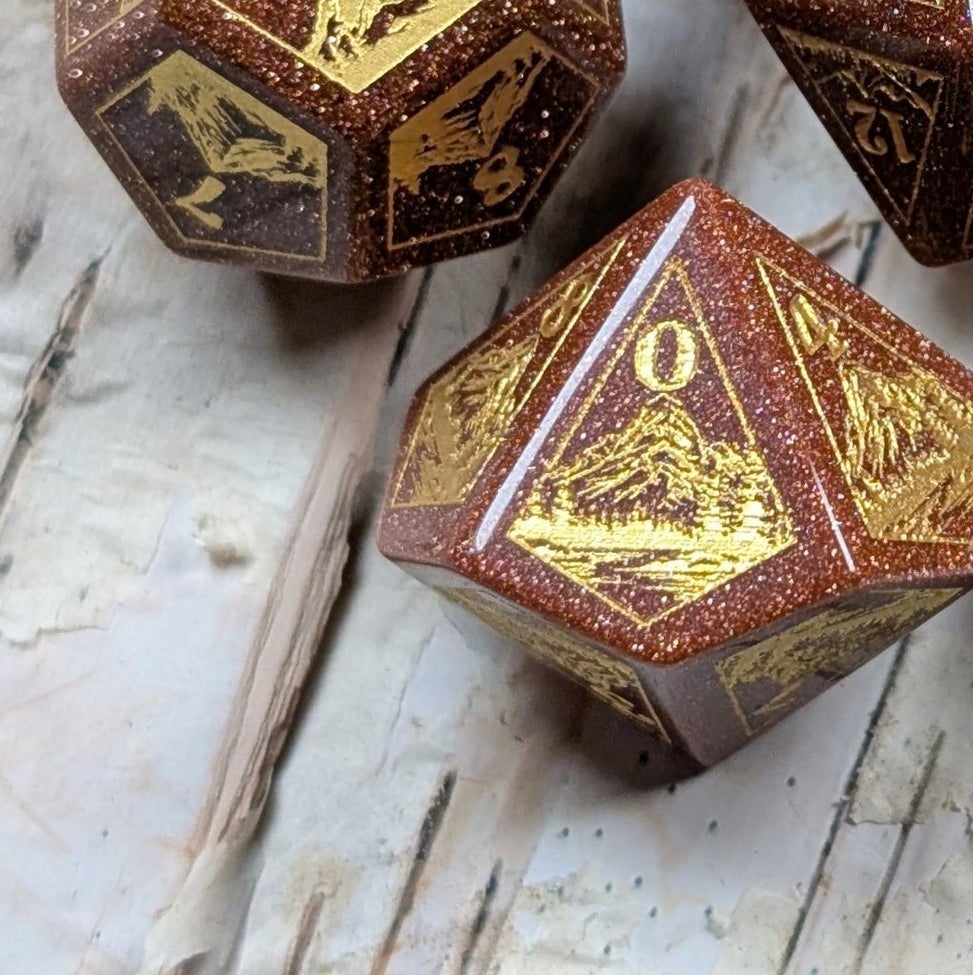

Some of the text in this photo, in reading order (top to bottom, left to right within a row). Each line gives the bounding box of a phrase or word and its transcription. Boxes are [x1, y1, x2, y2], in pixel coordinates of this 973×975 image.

[845, 99, 915, 164] 12
[175, 175, 226, 230] 7
[473, 144, 525, 206] 8
[634, 319, 697, 392] 0
[790, 292, 848, 362] 4
